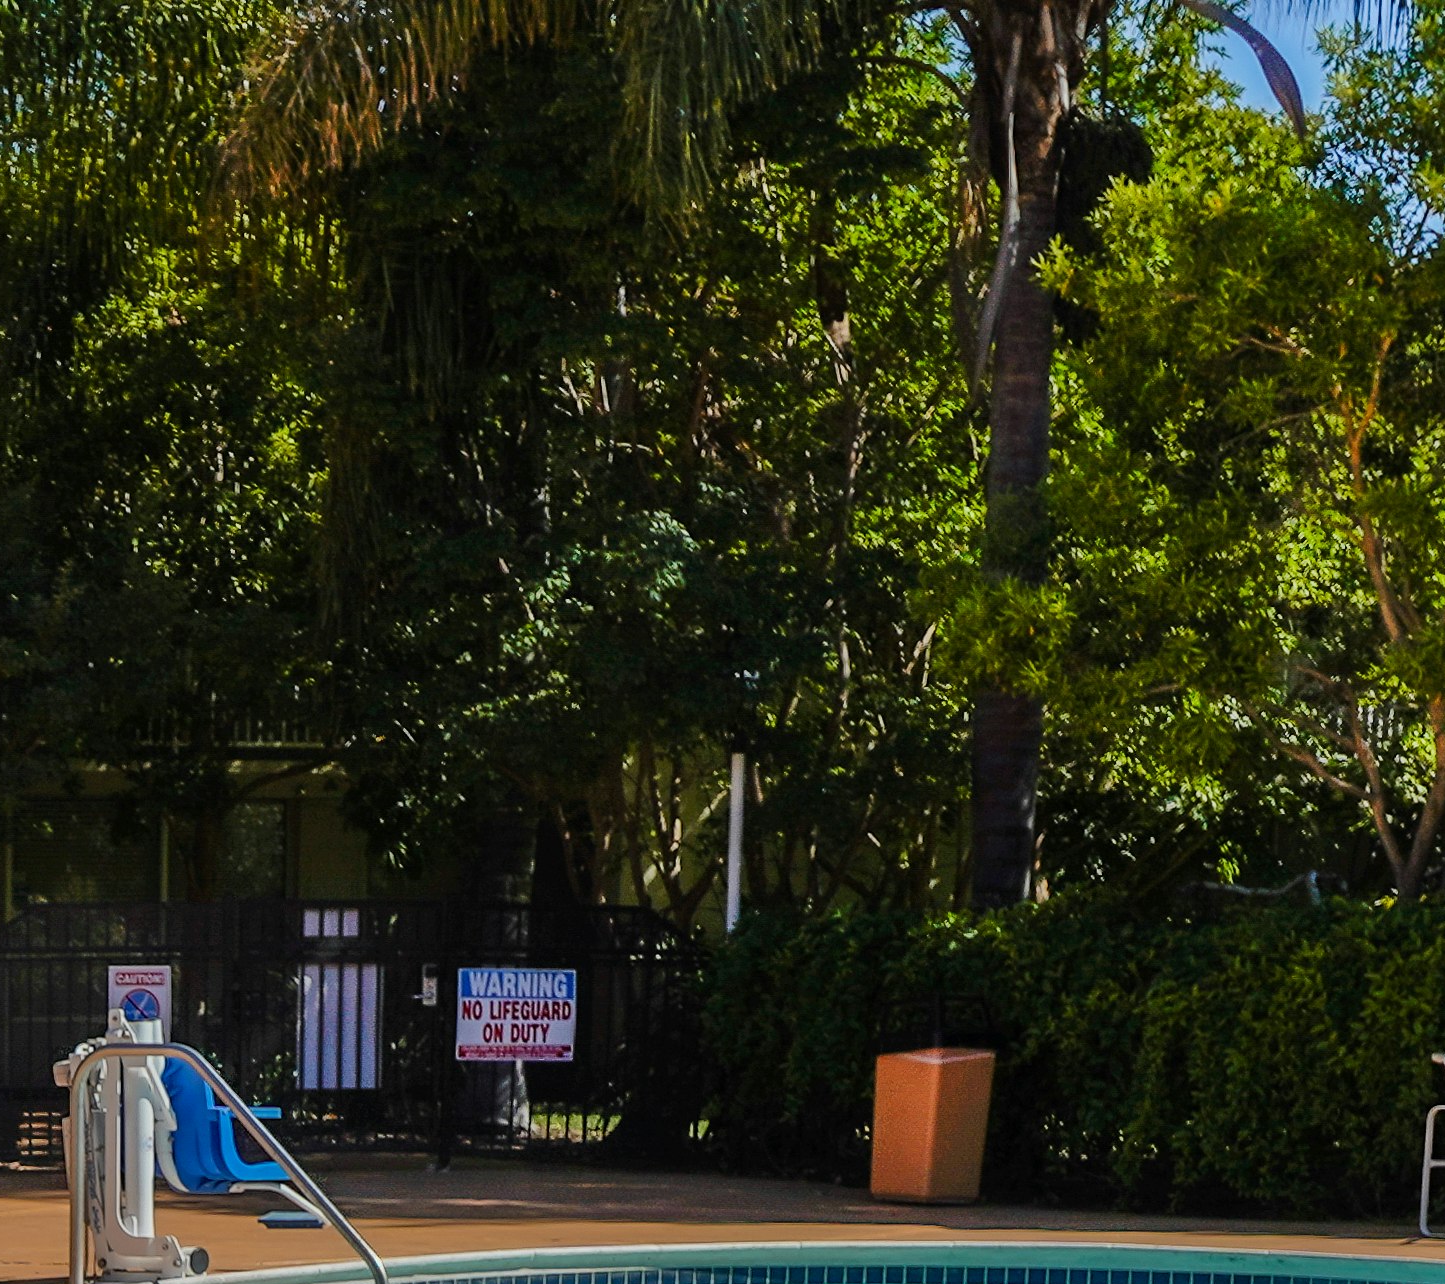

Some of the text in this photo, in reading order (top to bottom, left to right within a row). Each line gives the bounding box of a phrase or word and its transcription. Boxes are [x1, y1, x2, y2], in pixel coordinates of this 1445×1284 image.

[468, 971, 568, 998] WARNING
[462, 1000, 572, 1021] NO LIFEGUARD
[483, 1022, 550, 1044] ON DUTY
